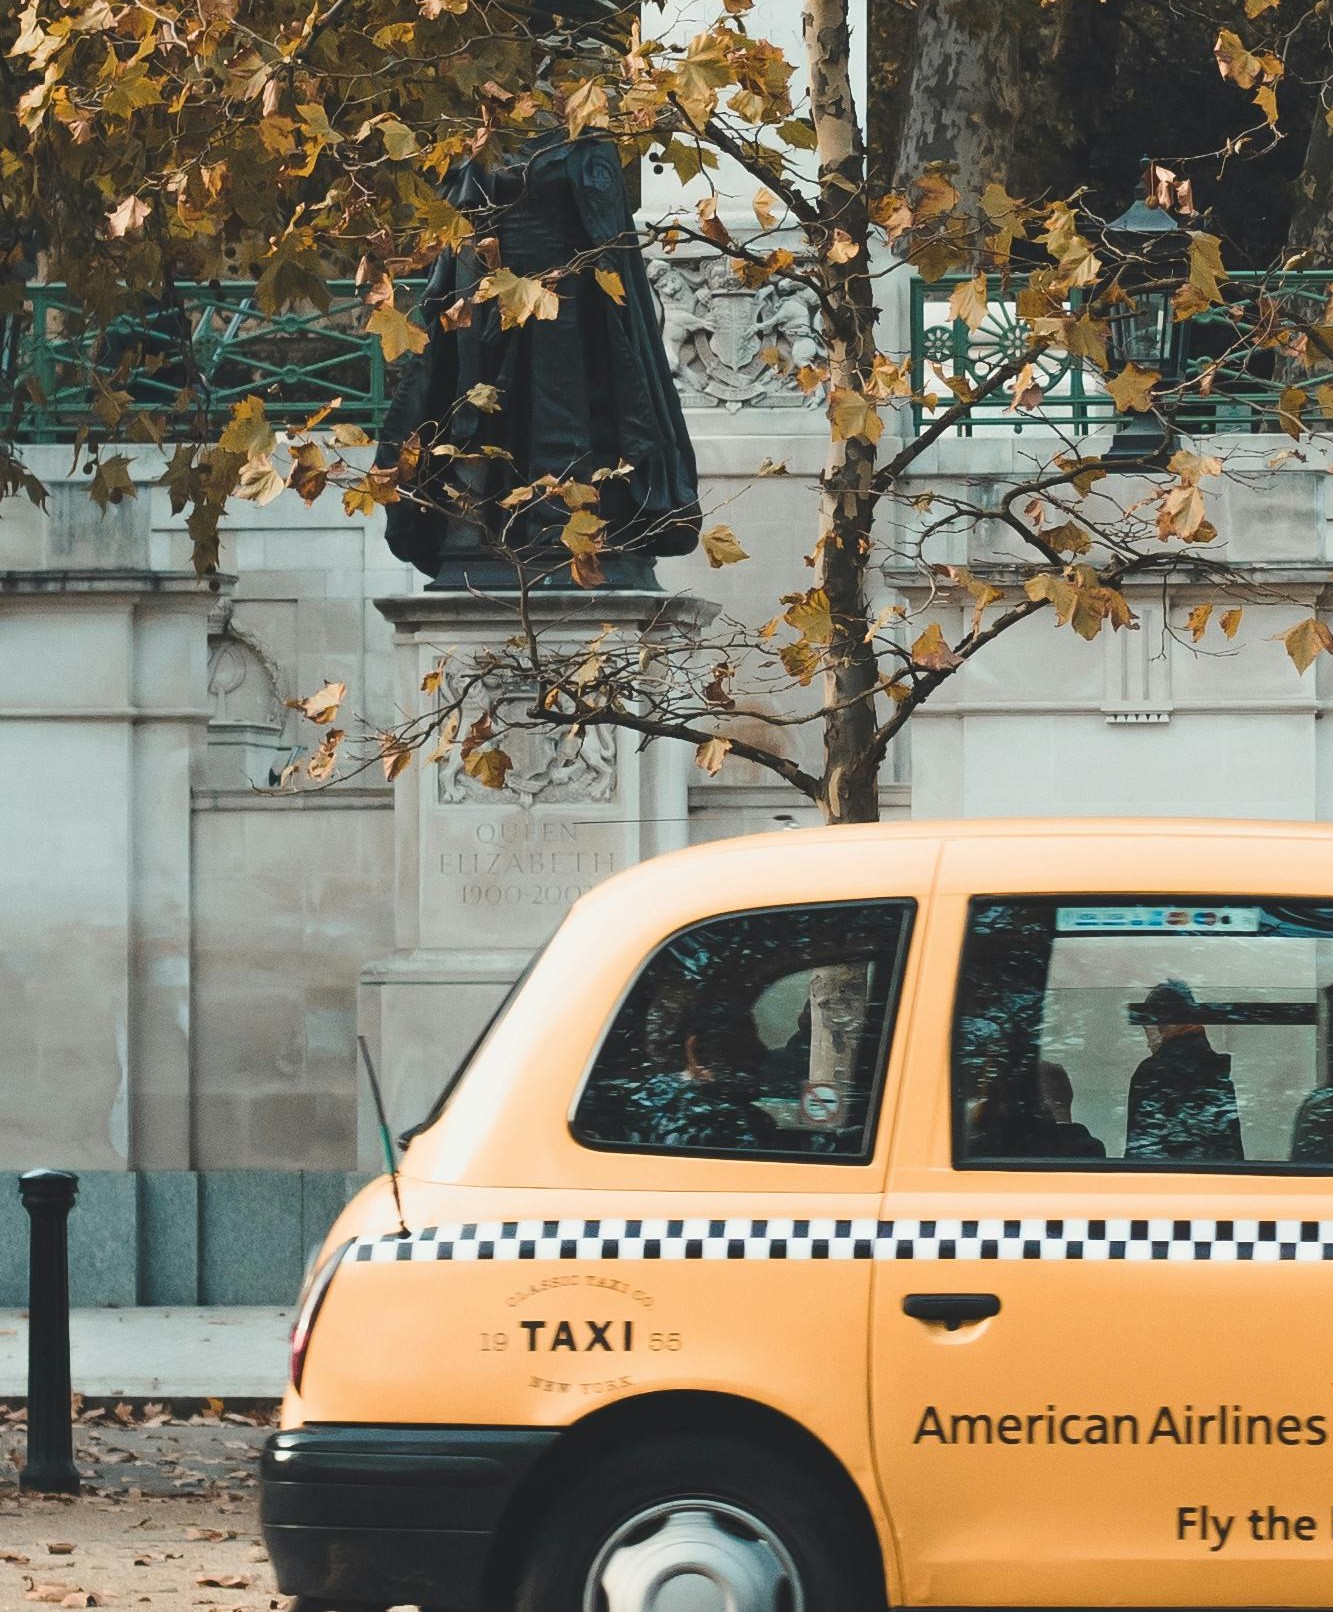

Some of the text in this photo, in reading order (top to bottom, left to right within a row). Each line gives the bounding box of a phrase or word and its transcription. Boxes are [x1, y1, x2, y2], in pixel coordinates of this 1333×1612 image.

[476, 823, 577, 849] QUEEN
[440, 853, 614, 875] ELIZABETH
[463, 885, 593, 905] 1900-200
[583, 1275, 631, 1294] TAXI
[480, 1332, 509, 1351] 19
[519, 1320, 633, 1352] TAXI
[913, 1404, 1138, 1445] American
[1147, 1404, 1328, 1446] Airlines
[1177, 1505, 1235, 1552] Fly
[1248, 1505, 1317, 1541] the
